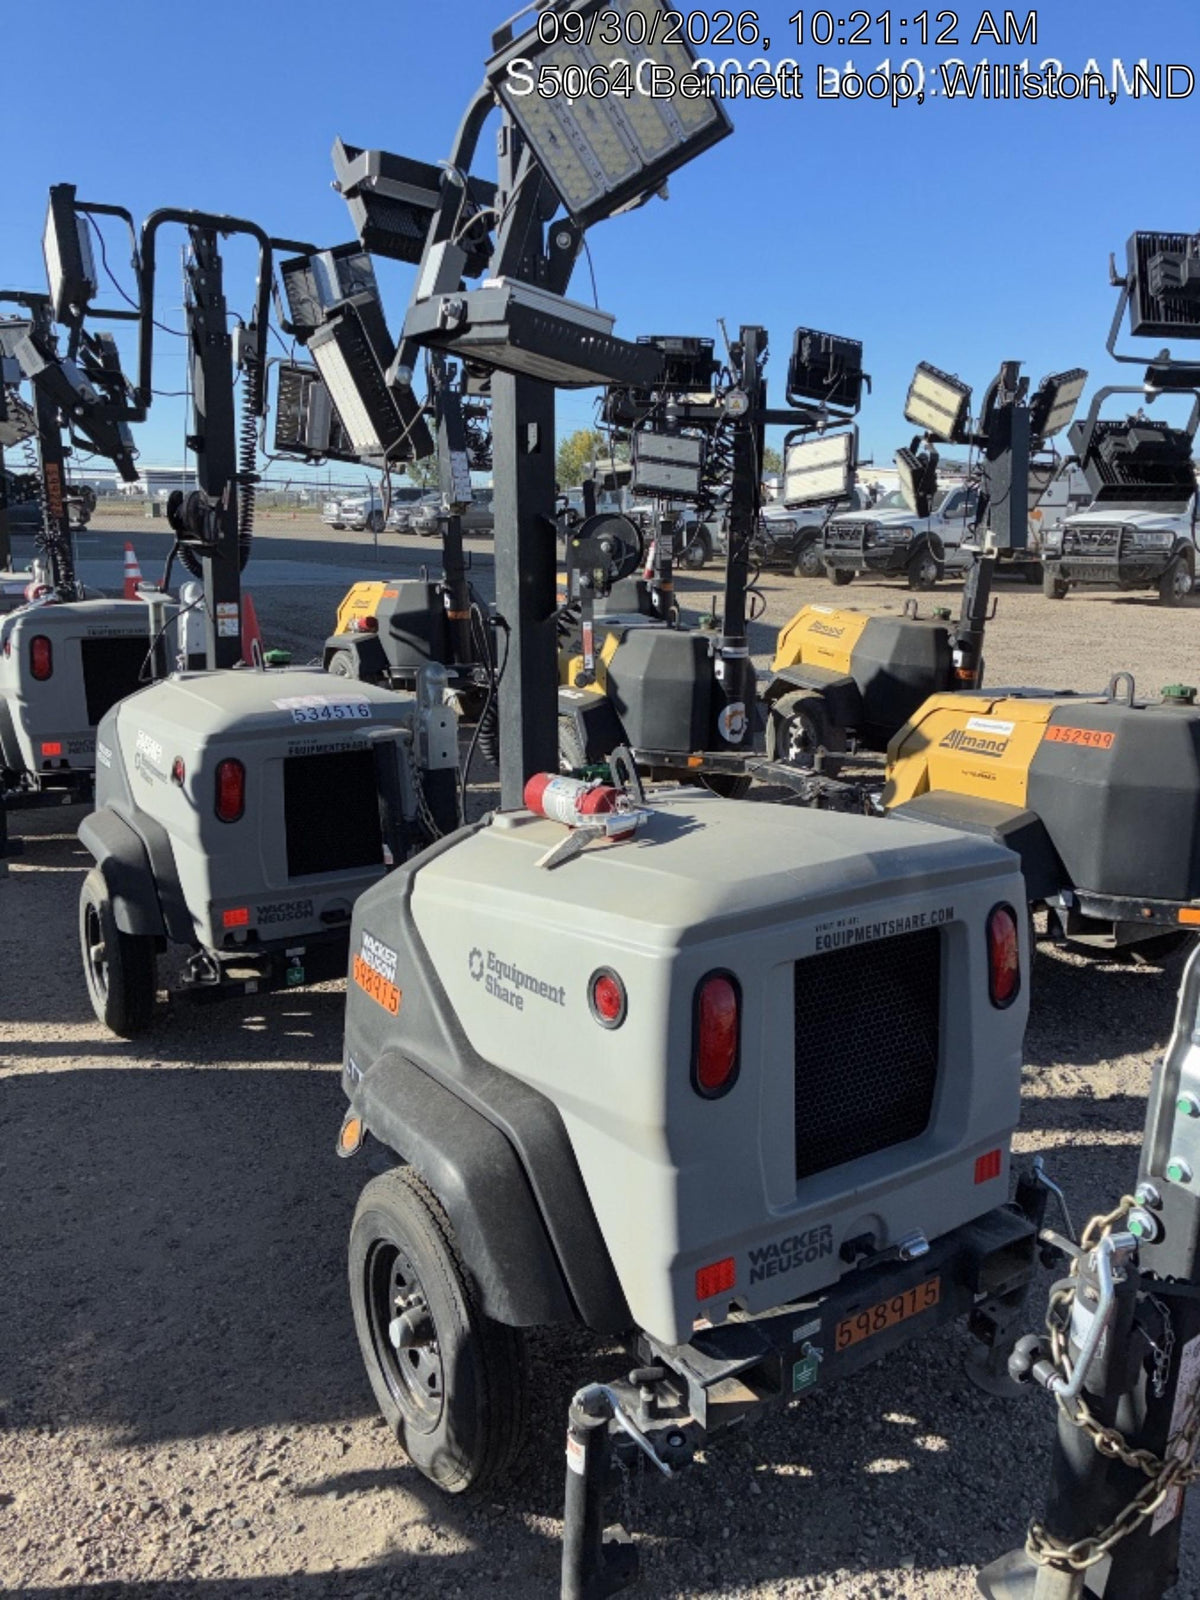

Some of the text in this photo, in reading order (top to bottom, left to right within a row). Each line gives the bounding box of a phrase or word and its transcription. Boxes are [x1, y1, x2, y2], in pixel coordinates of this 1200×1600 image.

[293, 703, 370, 721] 534516
[941, 728, 1011, 753] Allmand
[815, 907, 954, 950] EQUIPMENTSHARE.COM
[485, 974, 524, 1011] Share
[486, 950, 566, 1006] Equipment
[748, 1224, 833, 1266] WACKER
[750, 1240, 834, 1285] NEUSON
[838, 1279, 937, 1349] 598915
